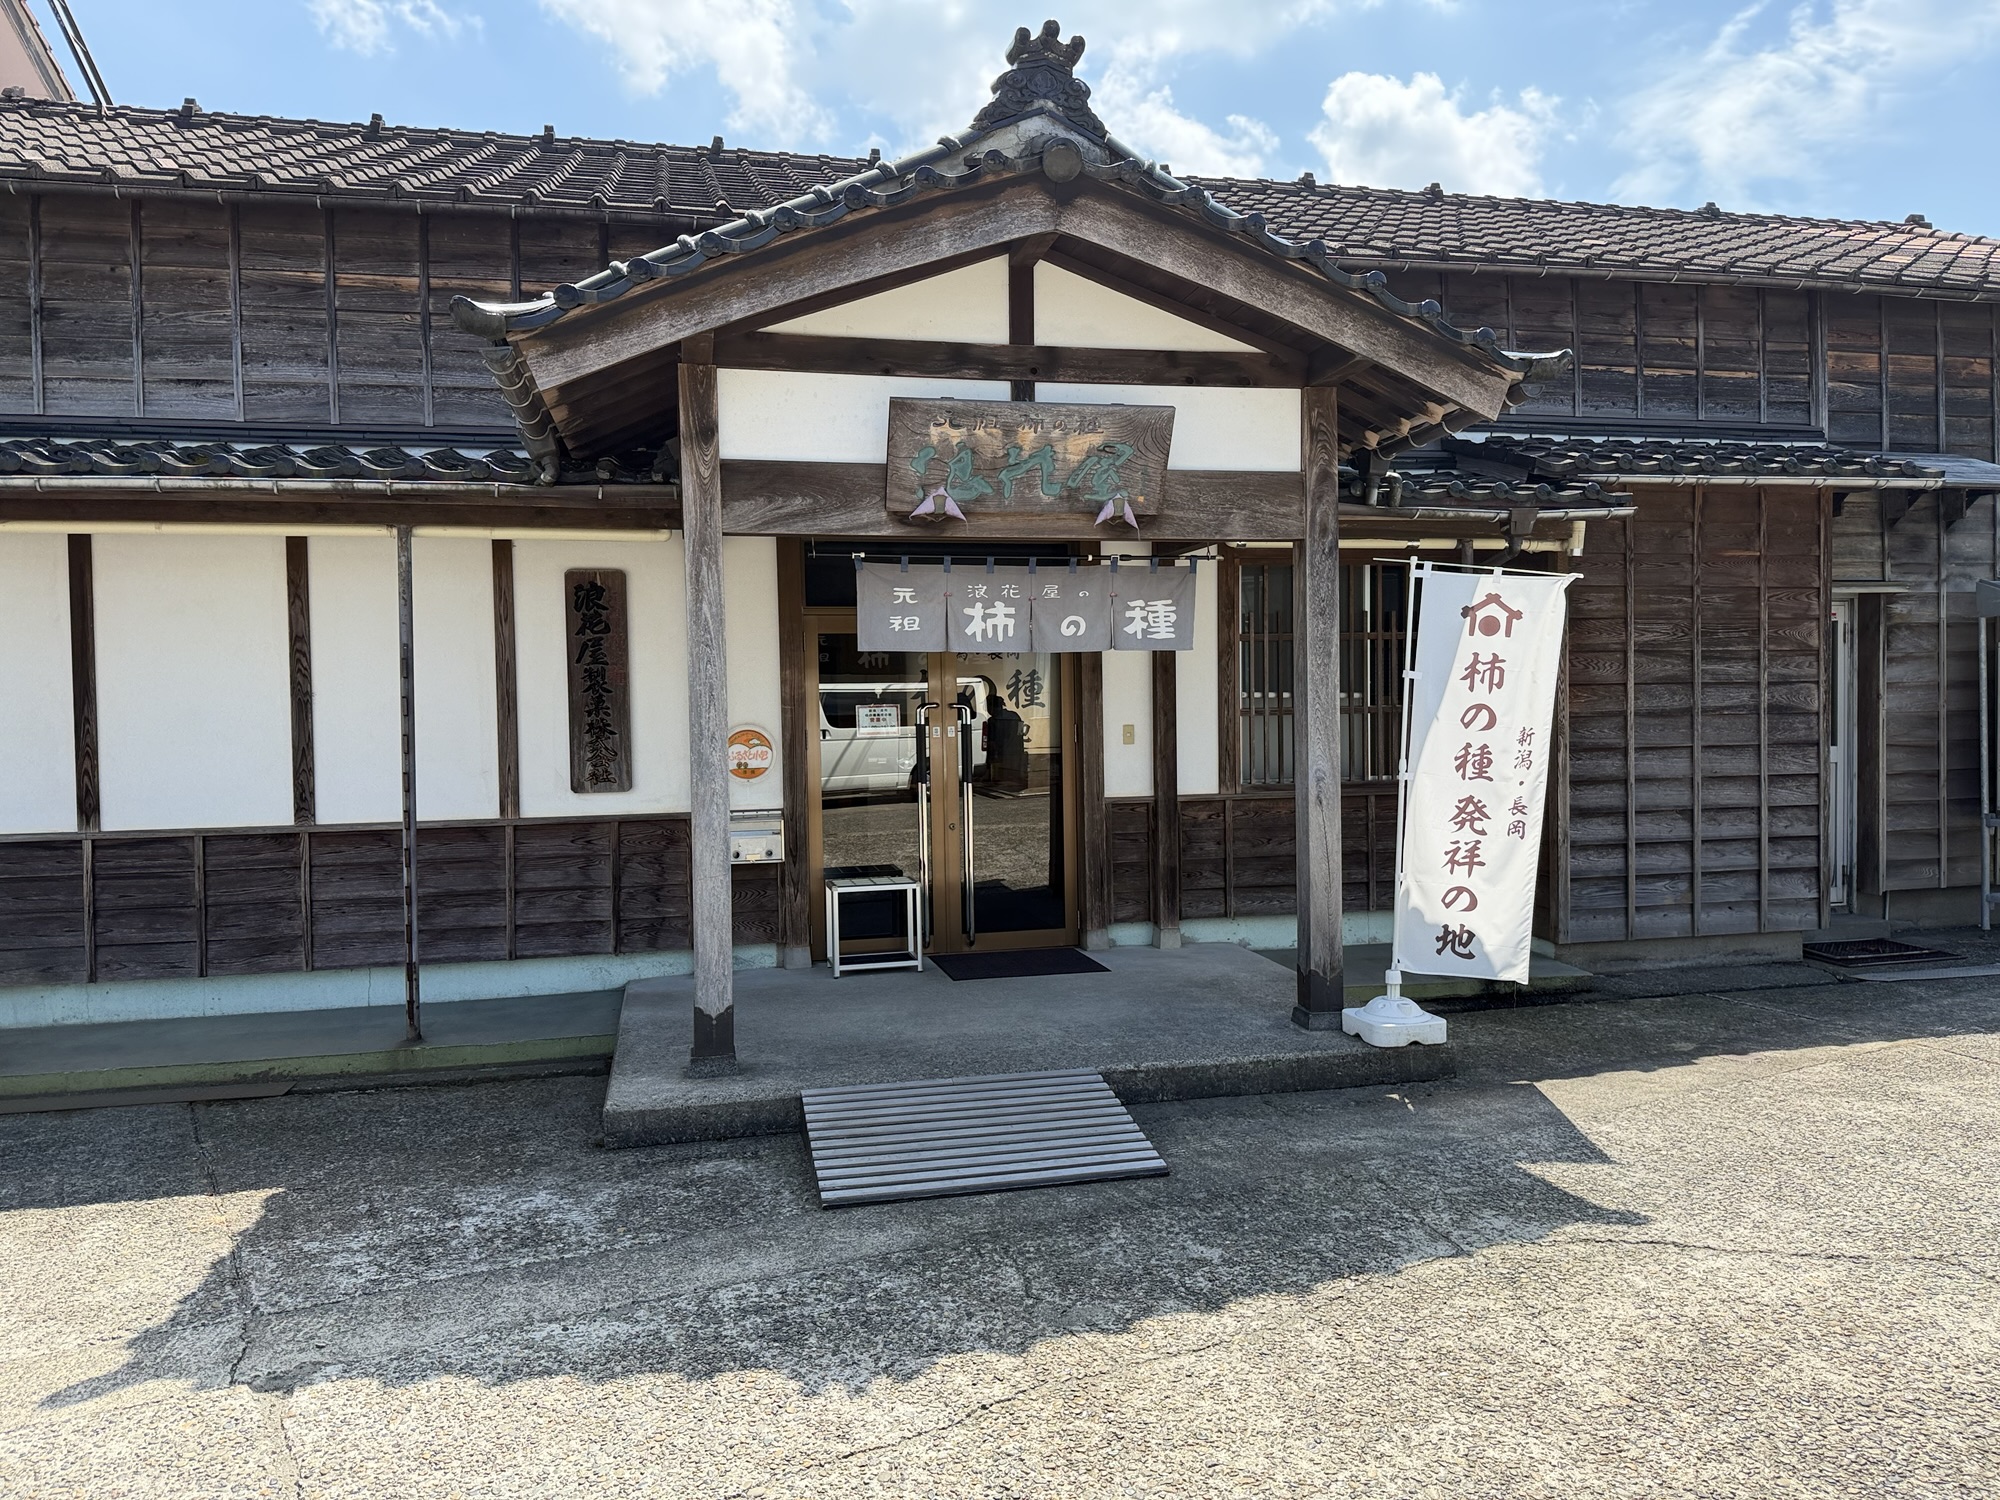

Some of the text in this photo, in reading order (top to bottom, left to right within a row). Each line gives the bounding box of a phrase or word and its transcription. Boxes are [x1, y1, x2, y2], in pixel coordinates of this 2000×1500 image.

[888, 587, 922, 633] 元祖
[962, 599, 1177, 642] 柿の種
[966, 584, 1090, 600] 浪花屋の
[573, 580, 619, 786] 浪花屋製菓株式会社
[1434, 651, 1506, 961] 柿の種発祥の地
[1506, 725, 1536, 841] 新潟・長岡
